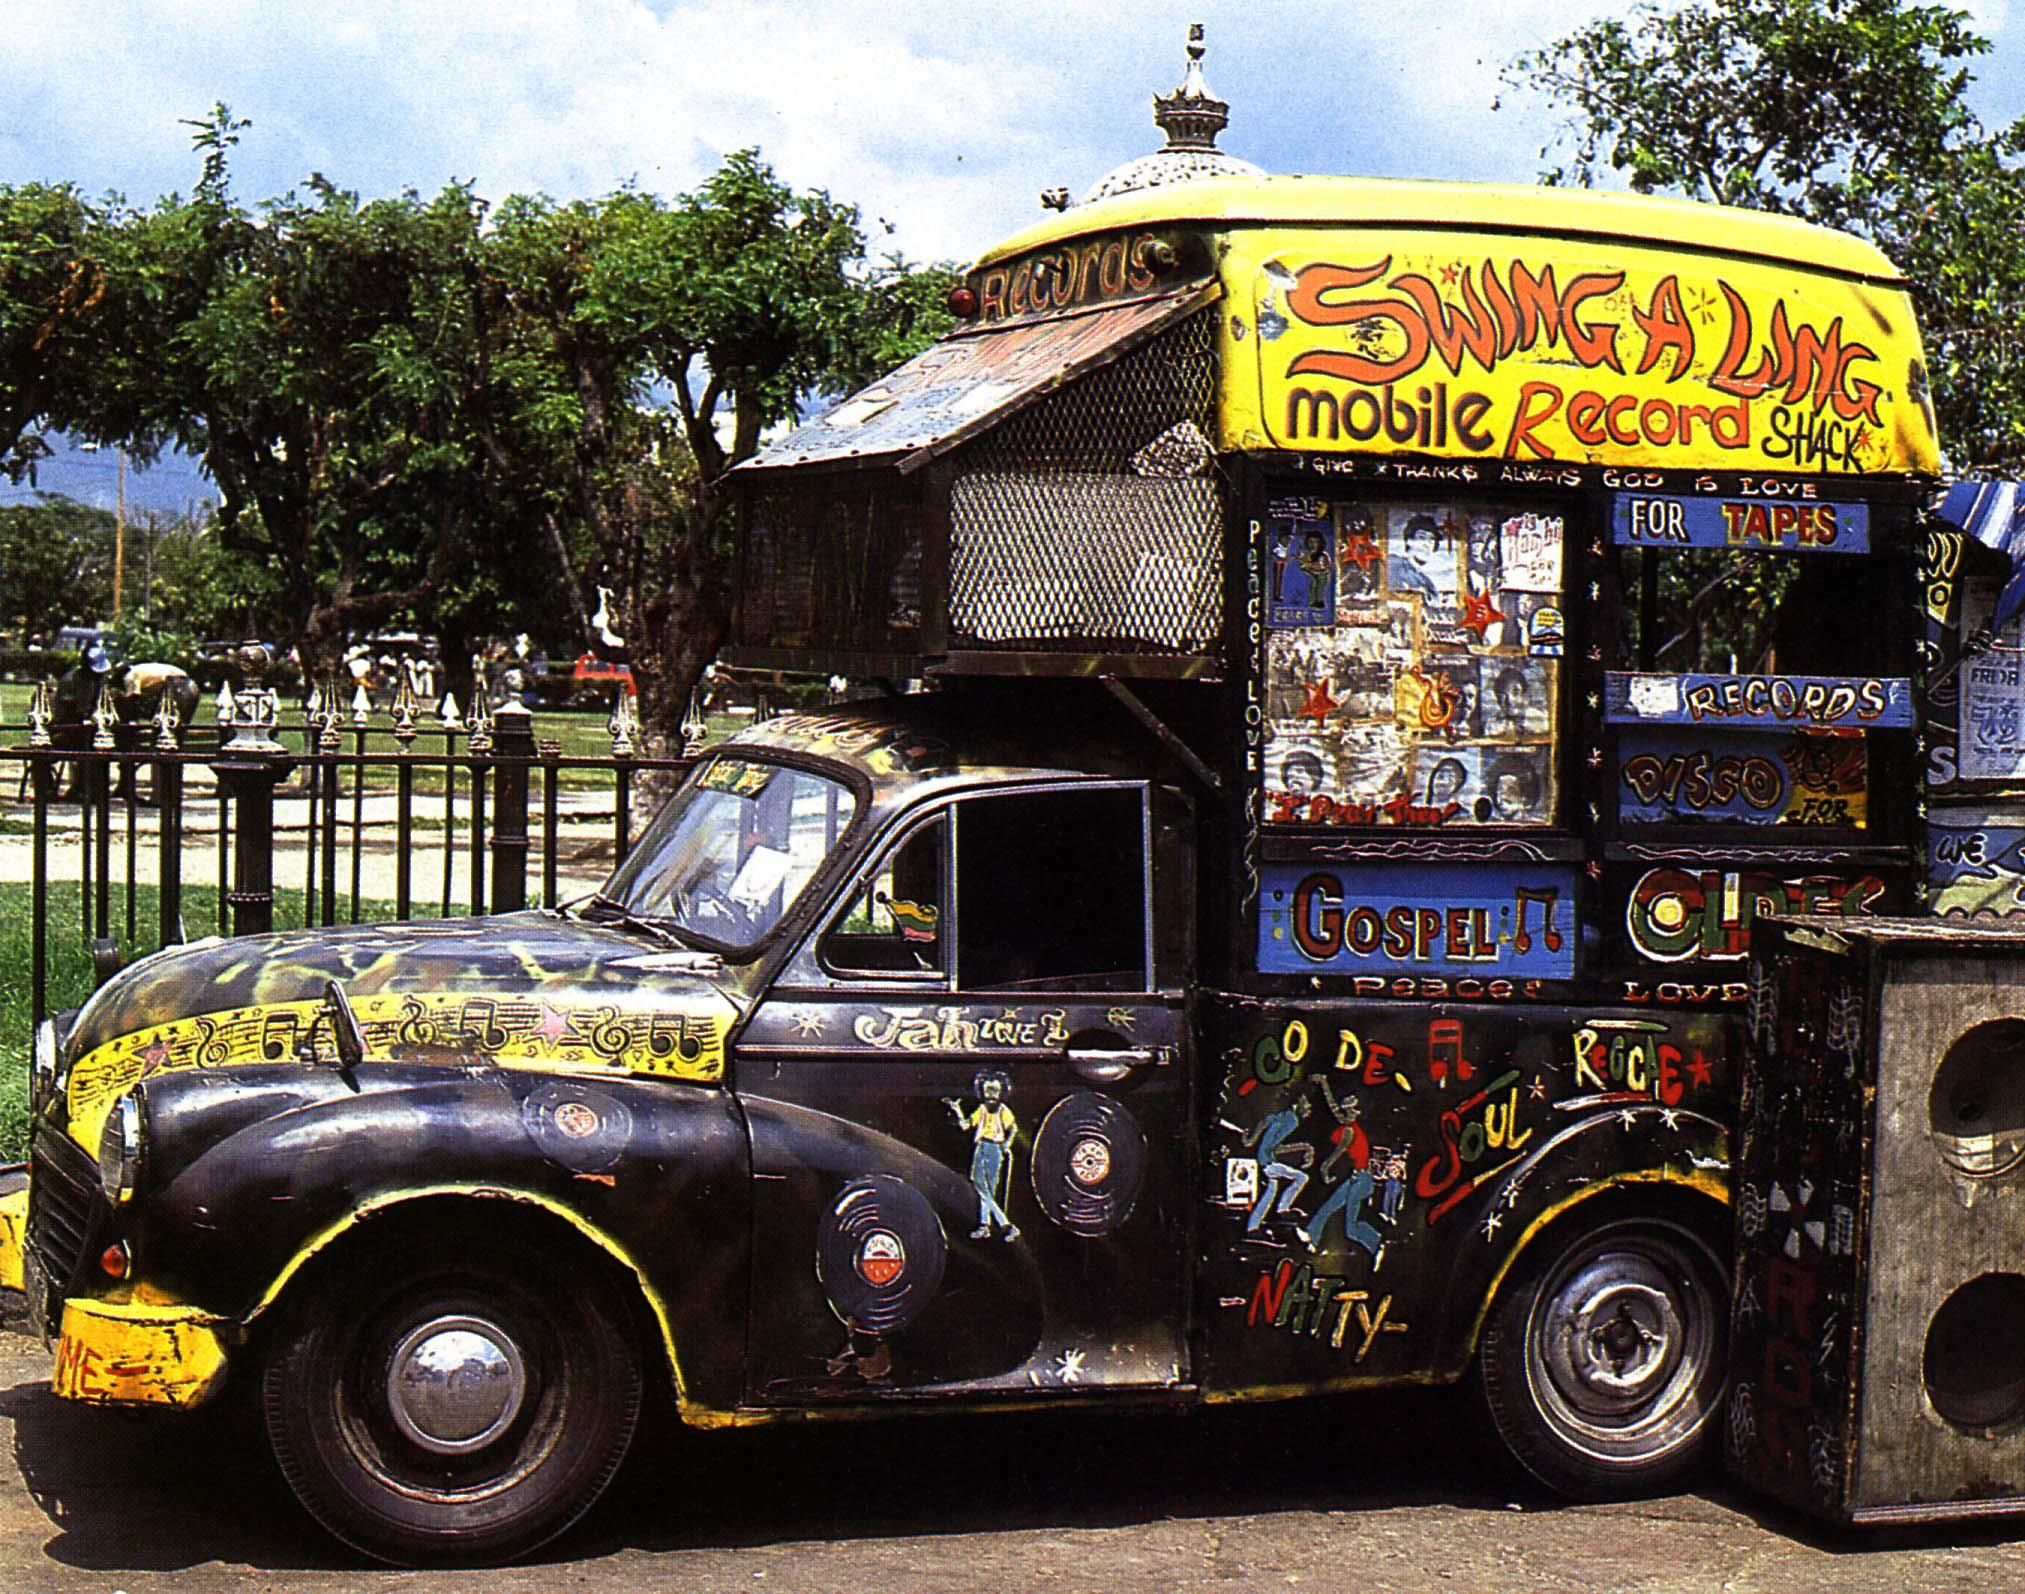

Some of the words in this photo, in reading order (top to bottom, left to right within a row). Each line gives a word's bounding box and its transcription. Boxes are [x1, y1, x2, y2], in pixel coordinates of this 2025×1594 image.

[1286, 254, 1627, 387] SWING
[1633, 274, 1694, 384] A
[1707, 278, 1884, 428] LING
[1286, 382, 1496, 452] mobile
[1503, 381, 1750, 459] Record
[1760, 405, 1864, 473] SHACK
[1602, 468, 1664, 489] GOD
[1739, 477, 1818, 498] LOVE
[1629, 499, 1690, 543] FOR
[1721, 502, 1837, 547] TAPES
[1686, 678, 1887, 722] RECORDS
[1623, 753, 1783, 811] DISCO
[1290, 872, 1500, 963] GOSPEL
